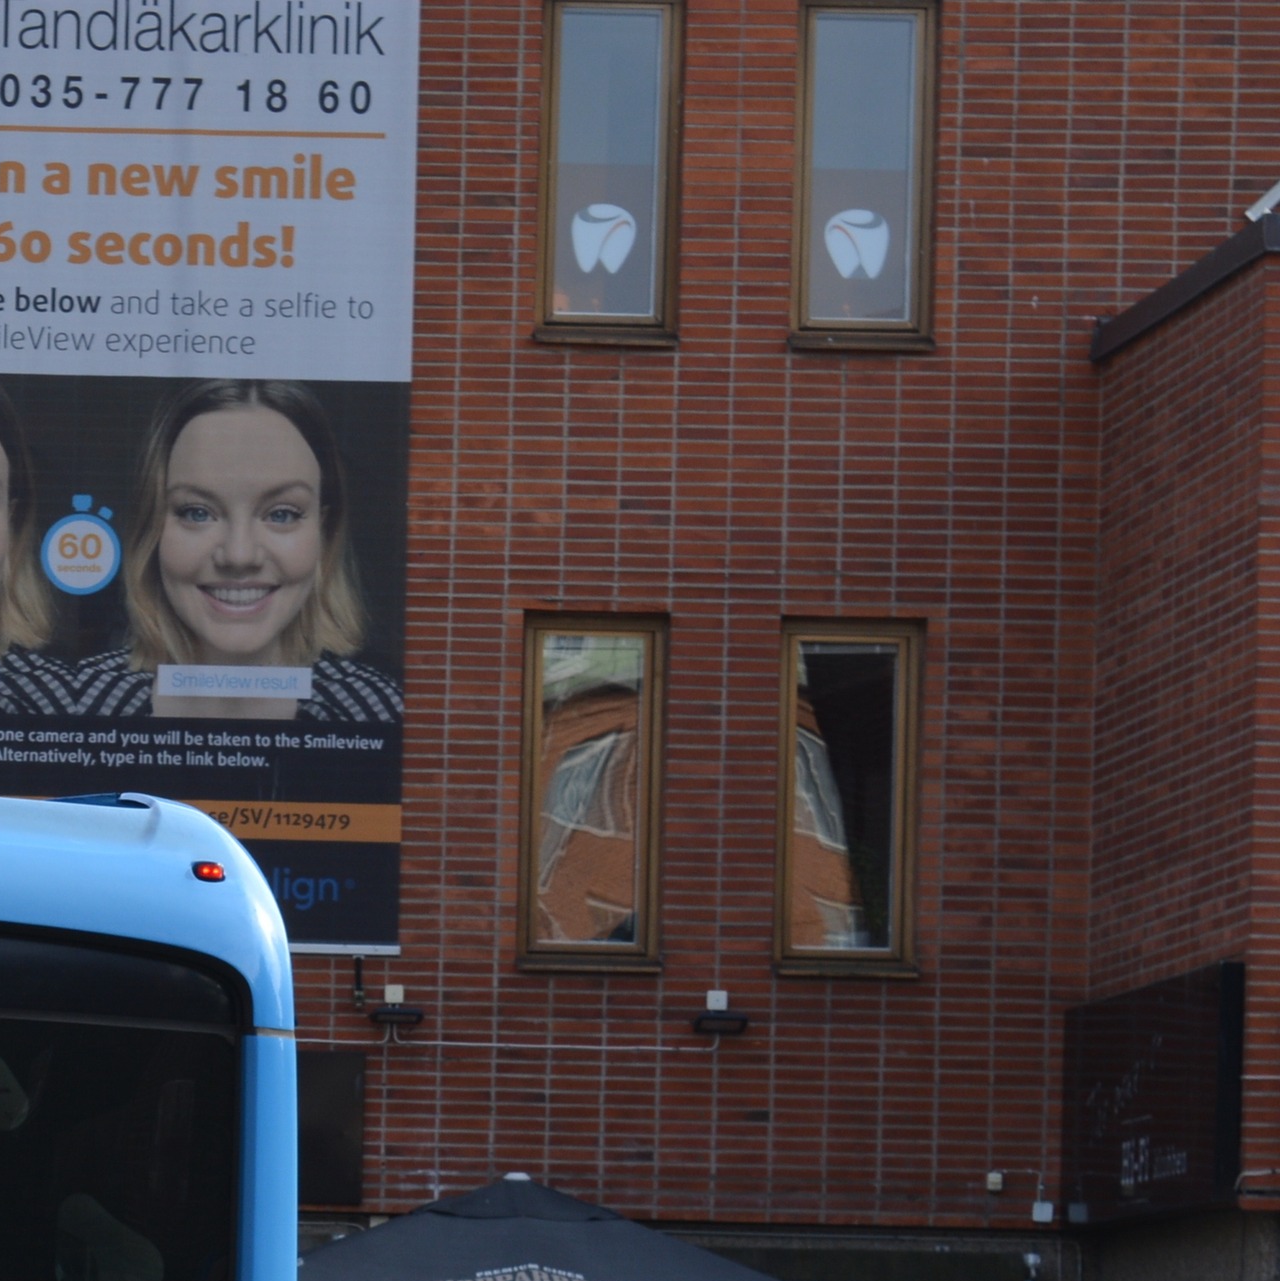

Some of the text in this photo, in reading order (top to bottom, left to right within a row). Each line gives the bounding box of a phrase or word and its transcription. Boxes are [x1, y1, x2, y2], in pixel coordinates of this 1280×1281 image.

[0, 74, 372, 114] 035-777 18 60
[42, 162, 71, 195] a
[87, 163, 200, 197] new
[214, 153, 356, 201] smile
[67, 221, 295, 268] seconds!
[15, 286, 101, 313] below
[110, 290, 160, 316] and
[170, 290, 228, 317] take
[239, 298, 254, 317] a
[264, 292, 337, 319] selfie
[347, 296, 374, 319] to
[105, 329, 256, 358] experience
[59, 533, 102, 559] 60
[172, 672, 298, 691] SmileView result
[28, 730, 83, 743] camera
[88, 729, 116, 744] and
[121, 731, 149, 747] you
[154, 731, 180, 745] will
[184, 732, 203, 746] be
[207, 732, 251, 747] taken
[255, 734, 270, 748] to
[275, 733, 300, 748] the
[304, 733, 383, 750] Smileview
[100, 751, 135, 767] type
[139, 751, 153, 765] in
[157, 751, 182, 766] the
[186, 751, 214, 766] link
[218, 752, 269, 767] below.
